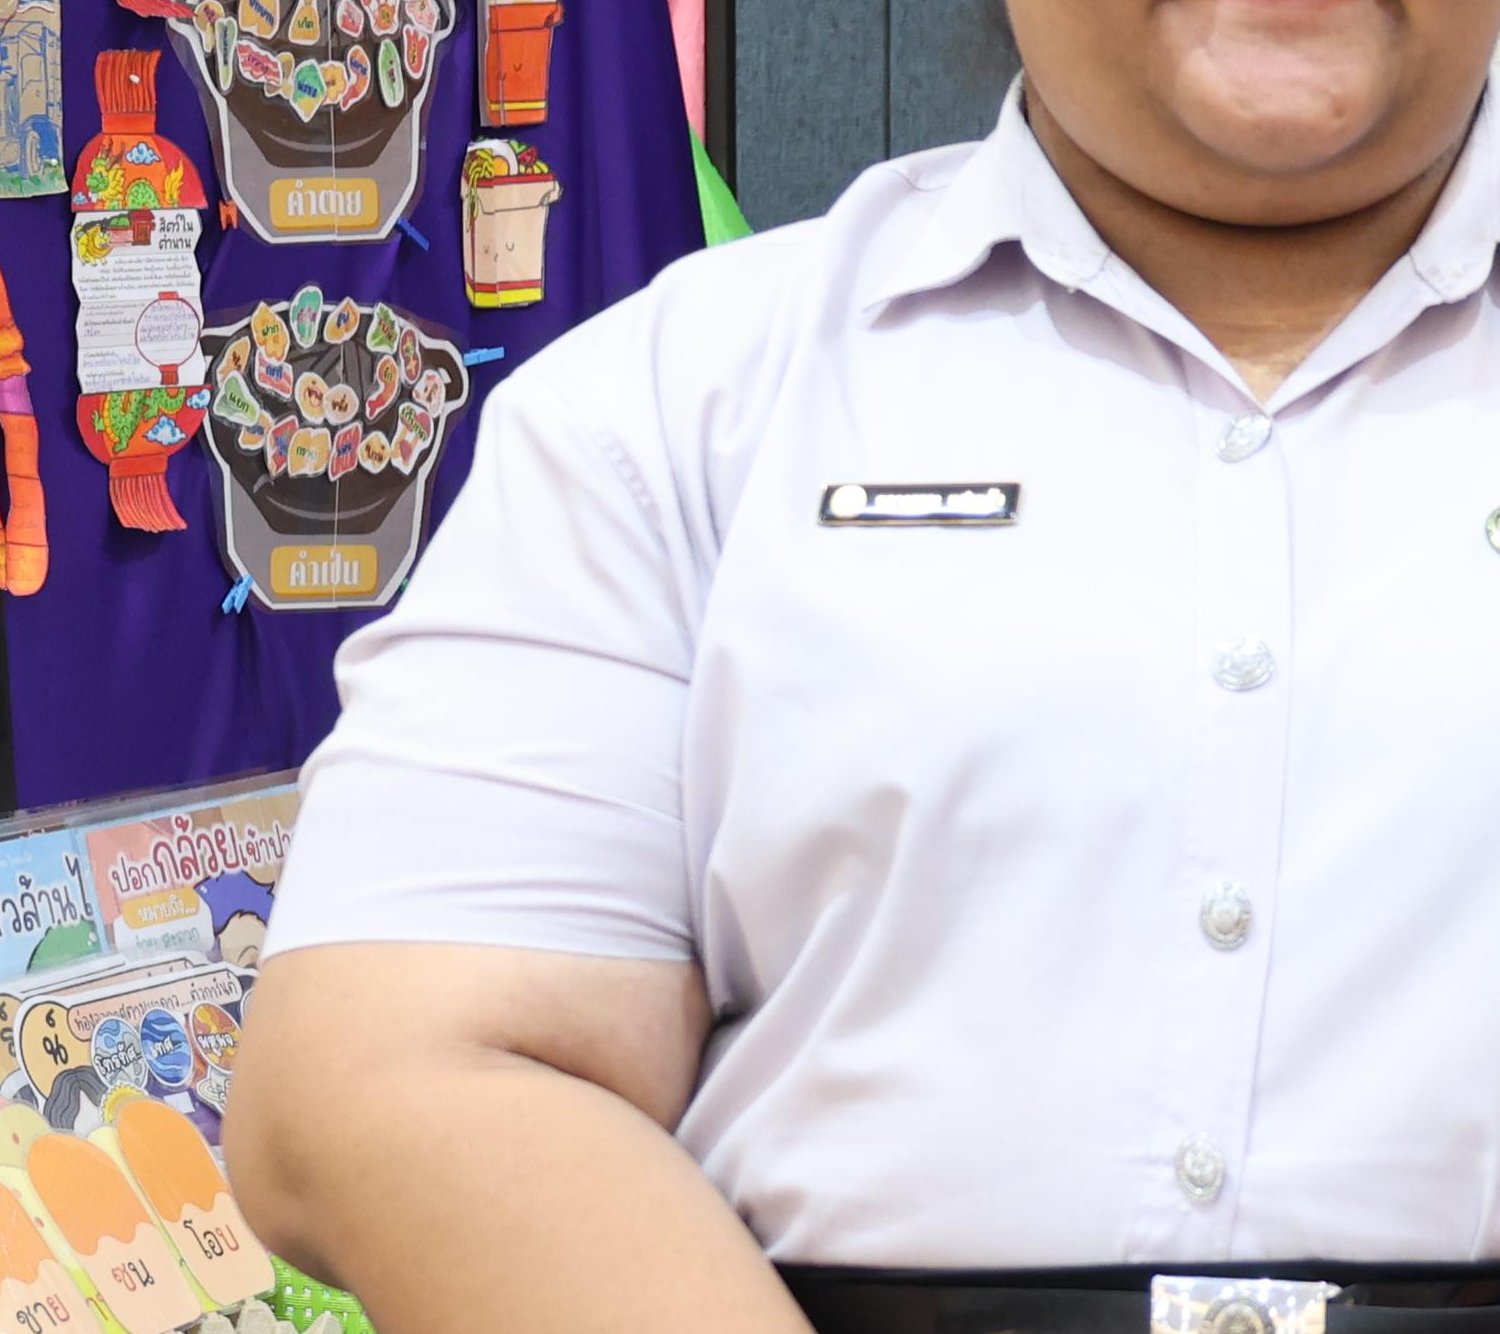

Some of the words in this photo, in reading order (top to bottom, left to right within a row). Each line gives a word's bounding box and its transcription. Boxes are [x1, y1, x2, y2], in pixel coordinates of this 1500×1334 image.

[285, 181, 365, 220] คำตาย
[158, 214, 194, 234] สัตว์ใน
[158, 236, 192, 251] ตำนาน
[288, 547, 362, 589] คำเป็น
[182, 1219, 240, 1260] โอบ
